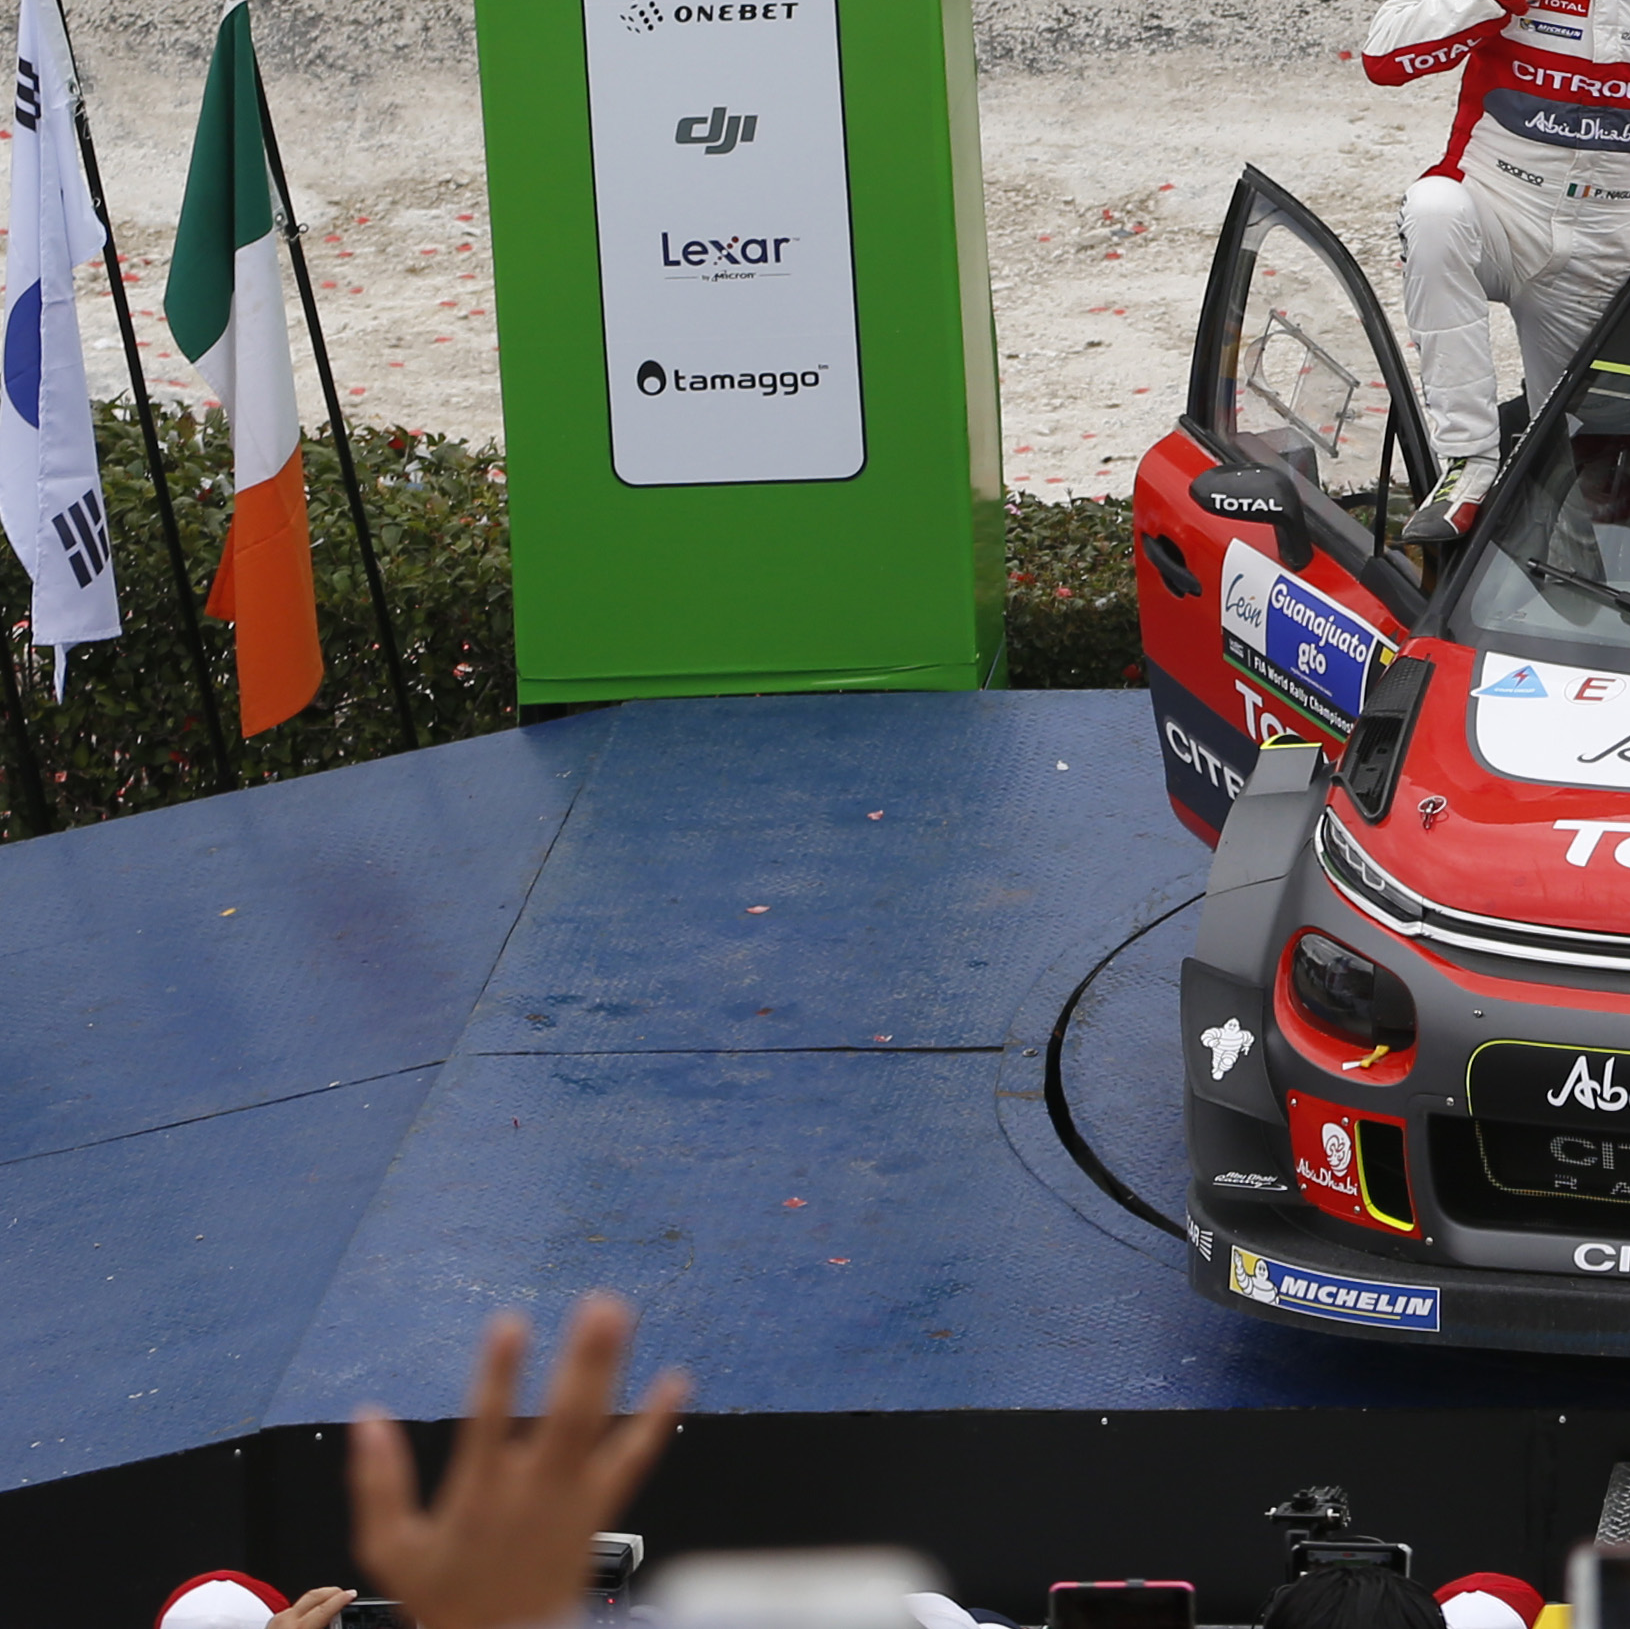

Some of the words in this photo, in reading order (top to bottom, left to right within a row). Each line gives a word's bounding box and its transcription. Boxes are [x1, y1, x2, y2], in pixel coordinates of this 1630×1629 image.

[674, 2, 799, 23] ONEBET
[1395, 36, 1483, 74] TOTAL
[661, 232, 791, 268] Lexar
[673, 367, 821, 396] tamaggo
[1210, 493, 1283, 512] TOTAL
[1225, 573, 1262, 628] León
[1270, 582, 1369, 664] Guanajuato
[1298, 642, 1327, 675] gto
[1253, 656, 1267, 676] FIA
[1266, 665, 1289, 691] World
[1289, 678, 1310, 707] Rally
[1573, 676, 1617, 702] E
[1279, 1275, 1434, 1318] MICHELIN
